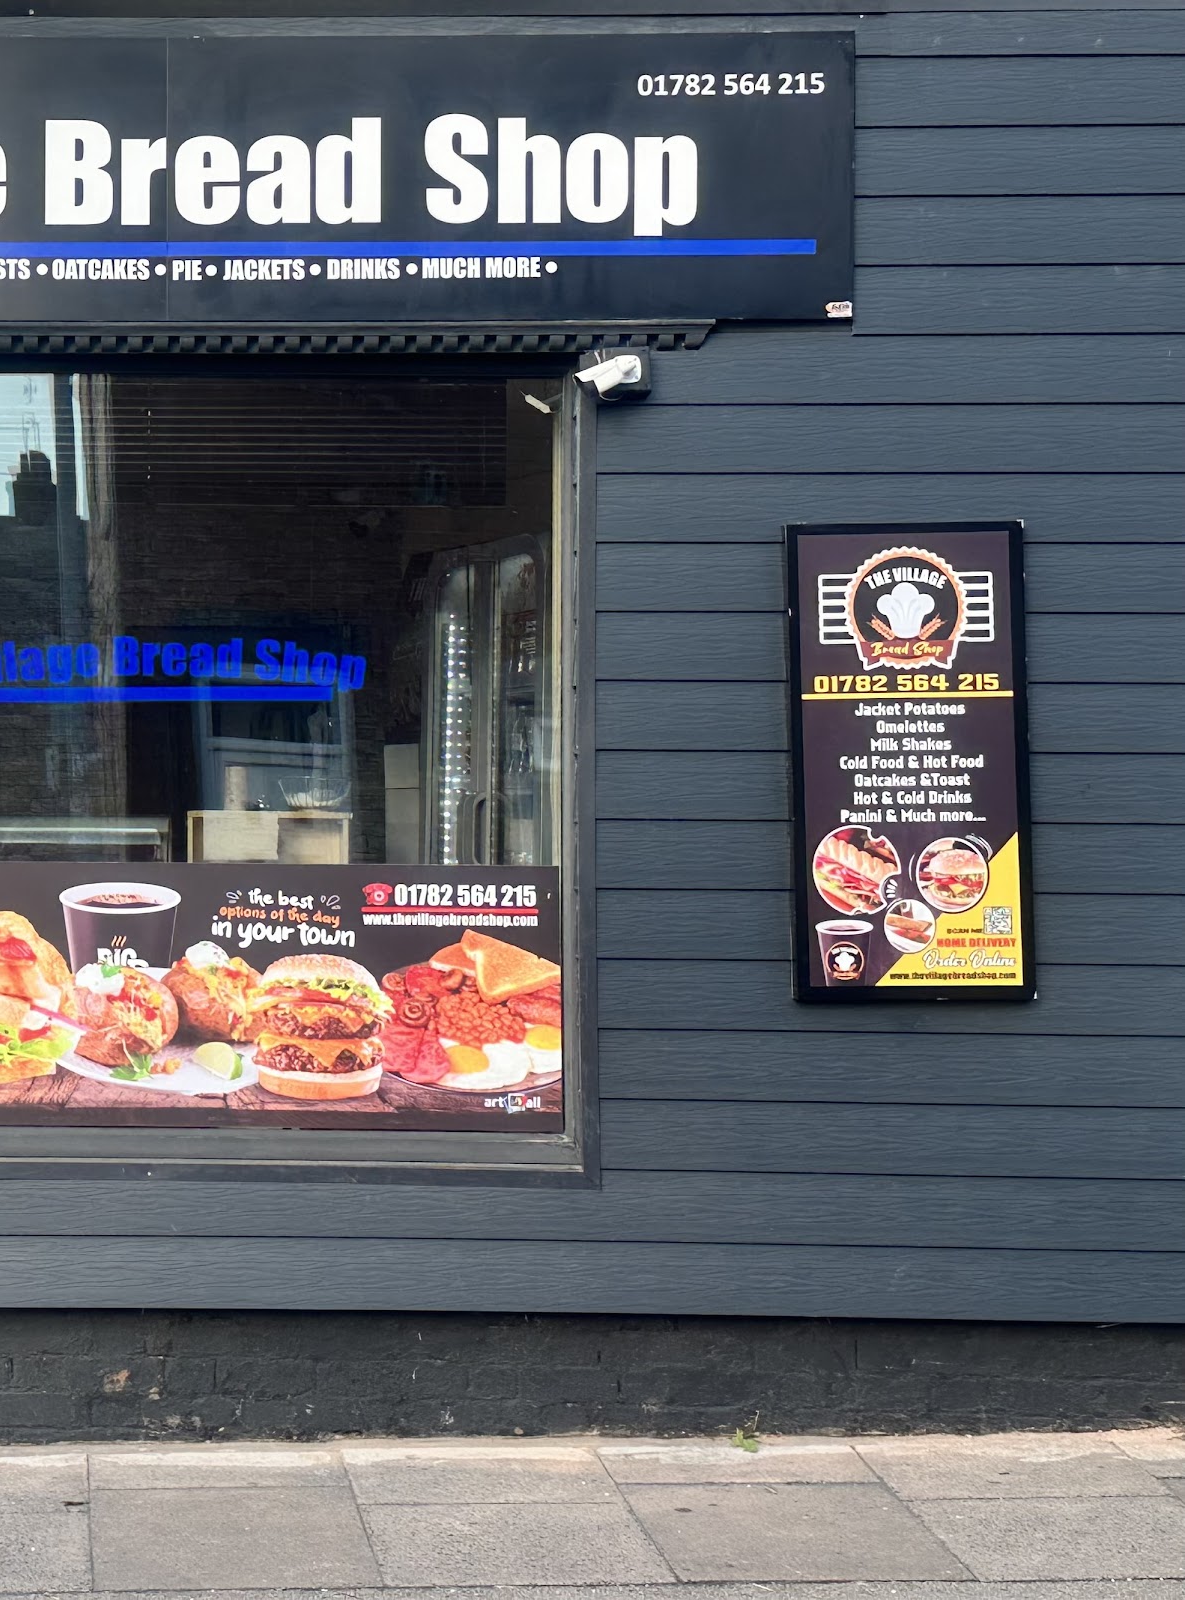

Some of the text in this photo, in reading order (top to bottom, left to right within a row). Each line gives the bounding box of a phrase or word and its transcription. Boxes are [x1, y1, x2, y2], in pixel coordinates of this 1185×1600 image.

[638, 72, 825, 97] 01782 564 215
[44, 116, 382, 226] Bread
[424, 113, 699, 237] Shop
[52, 257, 150, 281] OATCAKES
[172, 258, 202, 281] PIE
[223, 258, 305, 281] JACKETS
[327, 258, 401, 281] DRINKS
[422, 256, 480, 279] MUCH
[485, 256, 541, 279] MORE
[864, 567, 947, 590] THE VILLAGE
[870, 642, 944, 657] Bread Shop
[113, 635, 244, 679] Bread
[255, 639, 367, 692] Shop
[814, 673, 999, 693] 01782 564 215
[855, 702, 966, 716] Jacket Potatoes
[876, 720, 945, 733] Omelettes
[870, 737, 952, 751] Milk Shakes
[839, 754, 984, 769] Cold Food & Hot Food
[854, 773, 916, 787] Oatcakes
[853, 790, 973, 805] Hot & Cold Drinks
[840, 809, 882, 823] Panini
[886, 808, 898, 823] &
[900, 808, 936, 822] Much
[248, 888, 314, 910] the best
[394, 883, 537, 907] 01782 564 215
[219, 906, 340, 928] options of the day
[363, 912, 539, 928] www.thevillagebreadshop.com
[211, 915, 355, 948] in your town
[937, 938, 1017, 947] HOME DELIVERY
[923, 948, 1017, 969] Order Online
